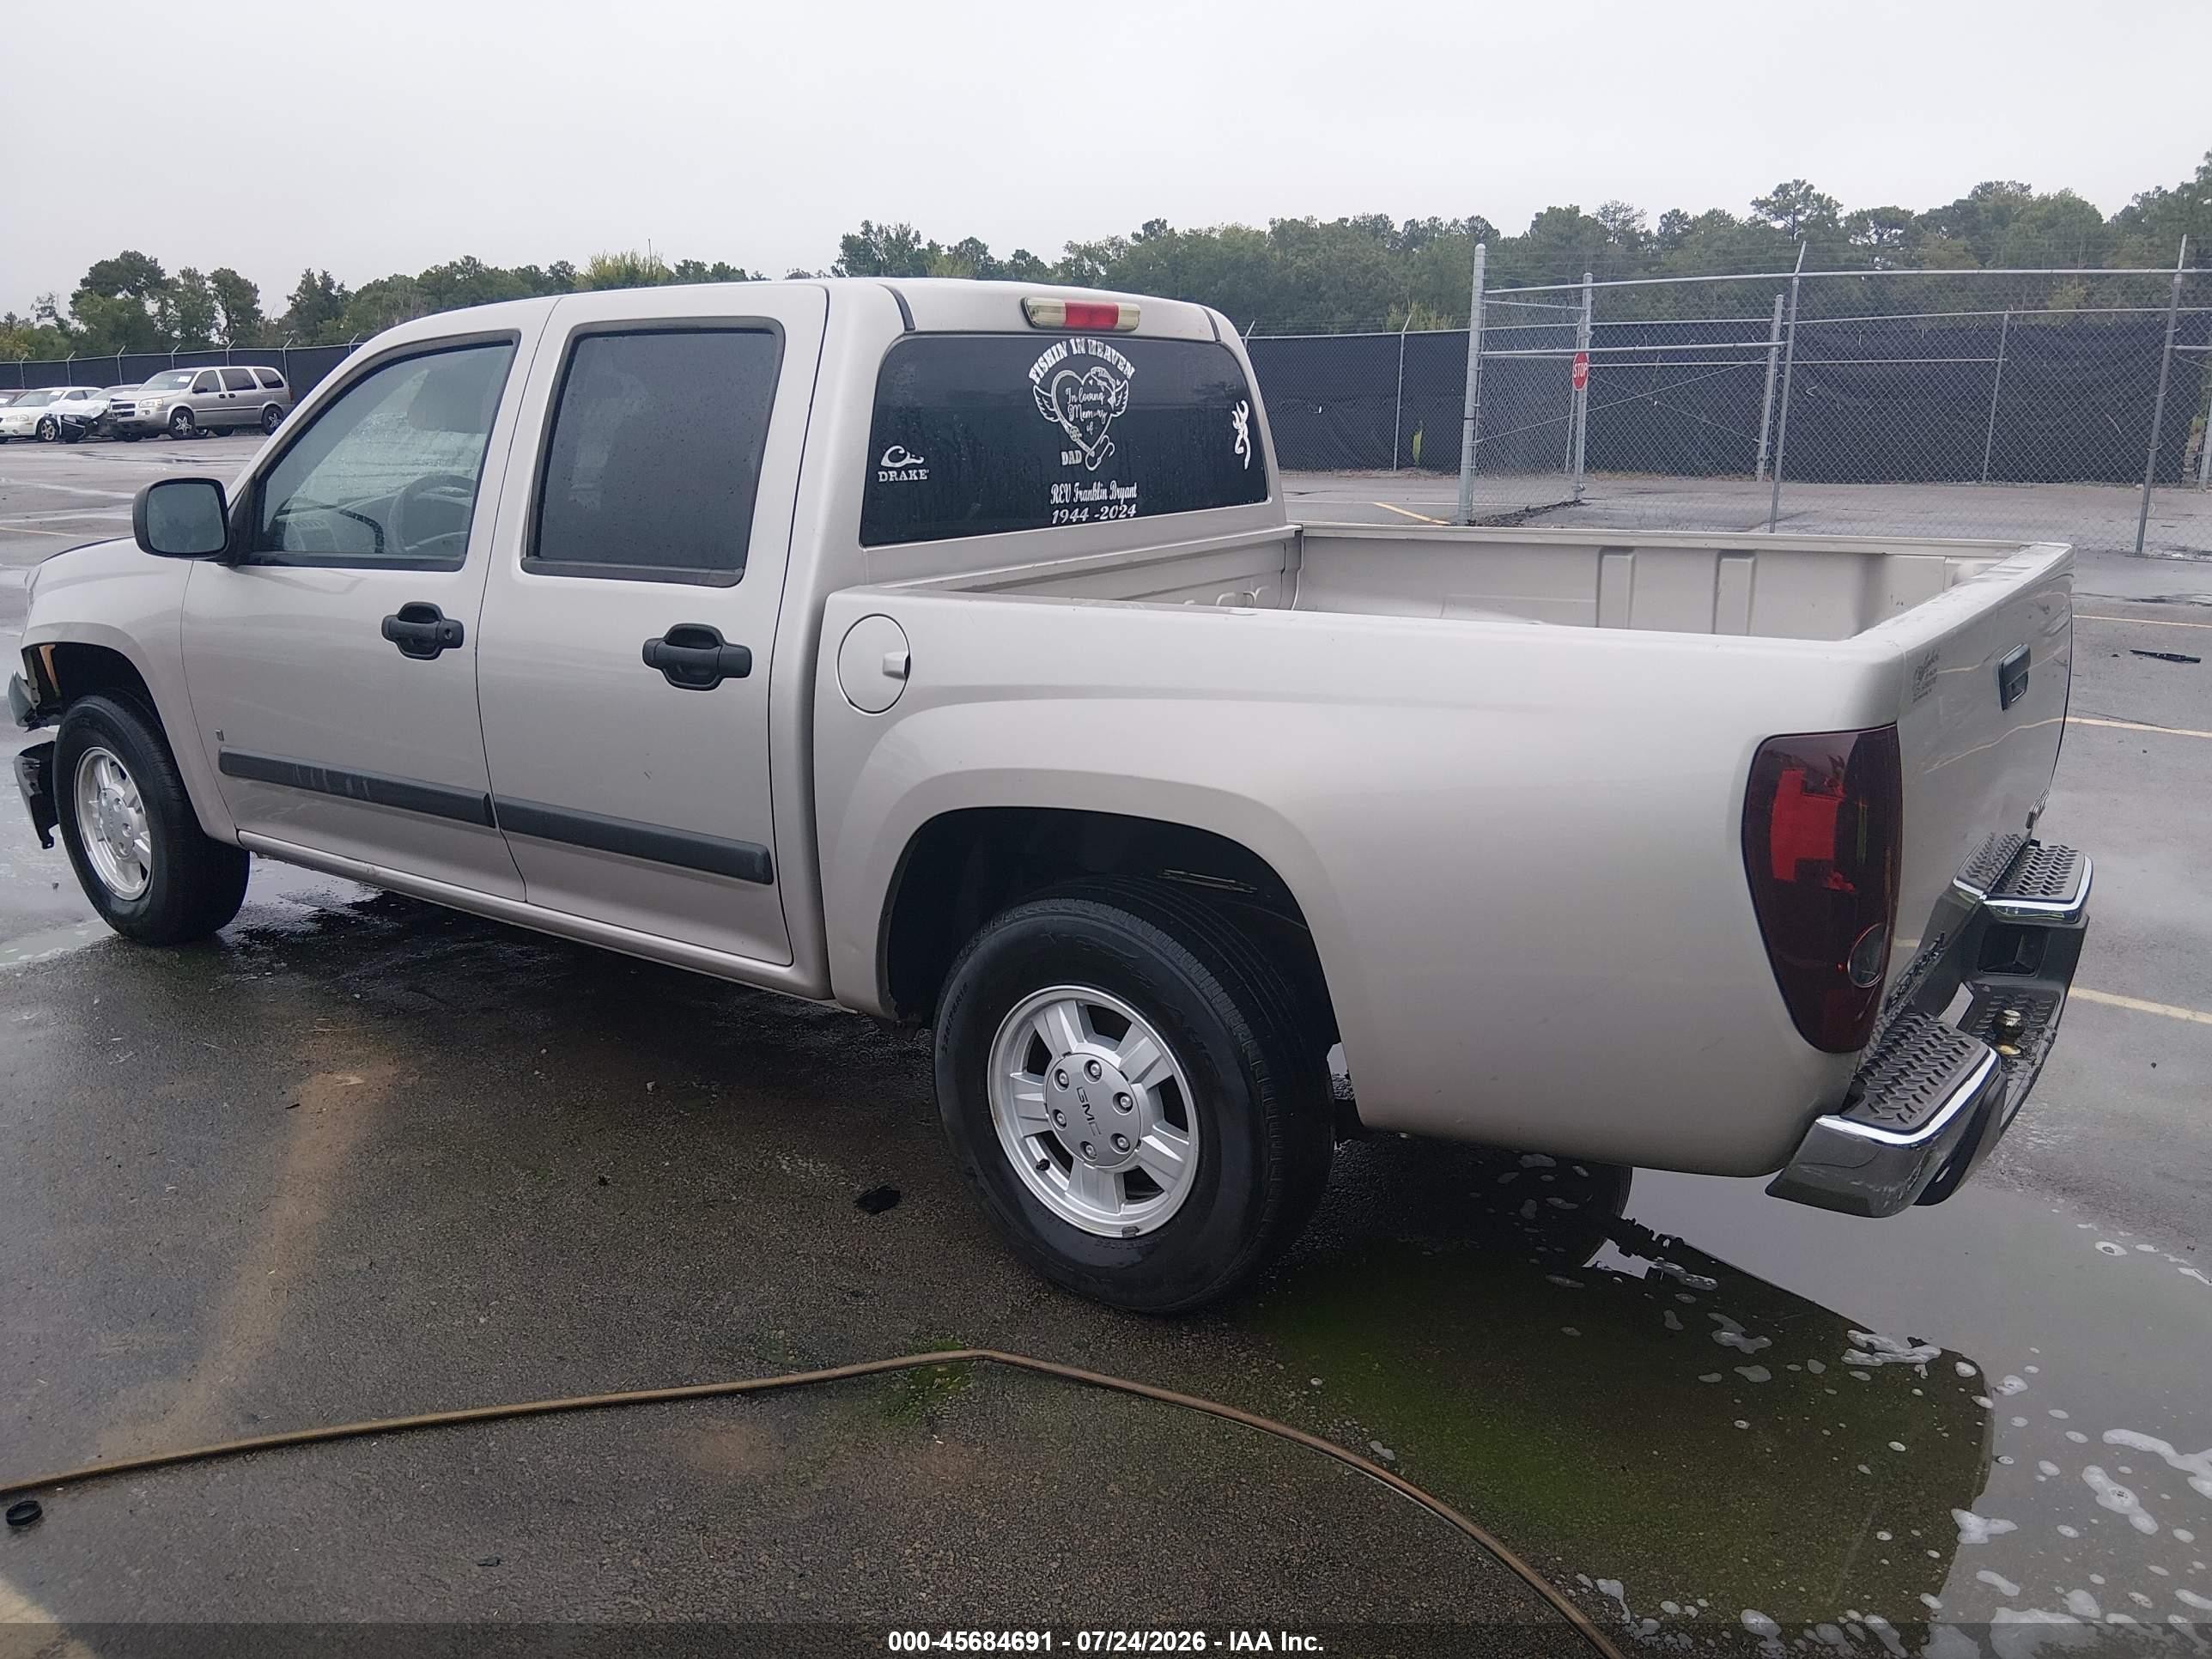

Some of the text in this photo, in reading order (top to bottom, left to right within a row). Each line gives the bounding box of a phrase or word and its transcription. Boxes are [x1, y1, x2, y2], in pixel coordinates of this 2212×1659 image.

[1029, 337, 1136, 385] FISHIN IN HEAVEN
[1573, 362, 1588, 379] STOP
[1065, 387, 1078, 404] In
[1060, 450, 1082, 465] DAD
[878, 469, 928, 483] DRAKE
[1050, 480, 1138, 505] REV Franklin Bryant
[1052, 507, 1090, 524] 1944
[1076, 1086, 1102, 1136] GMC
